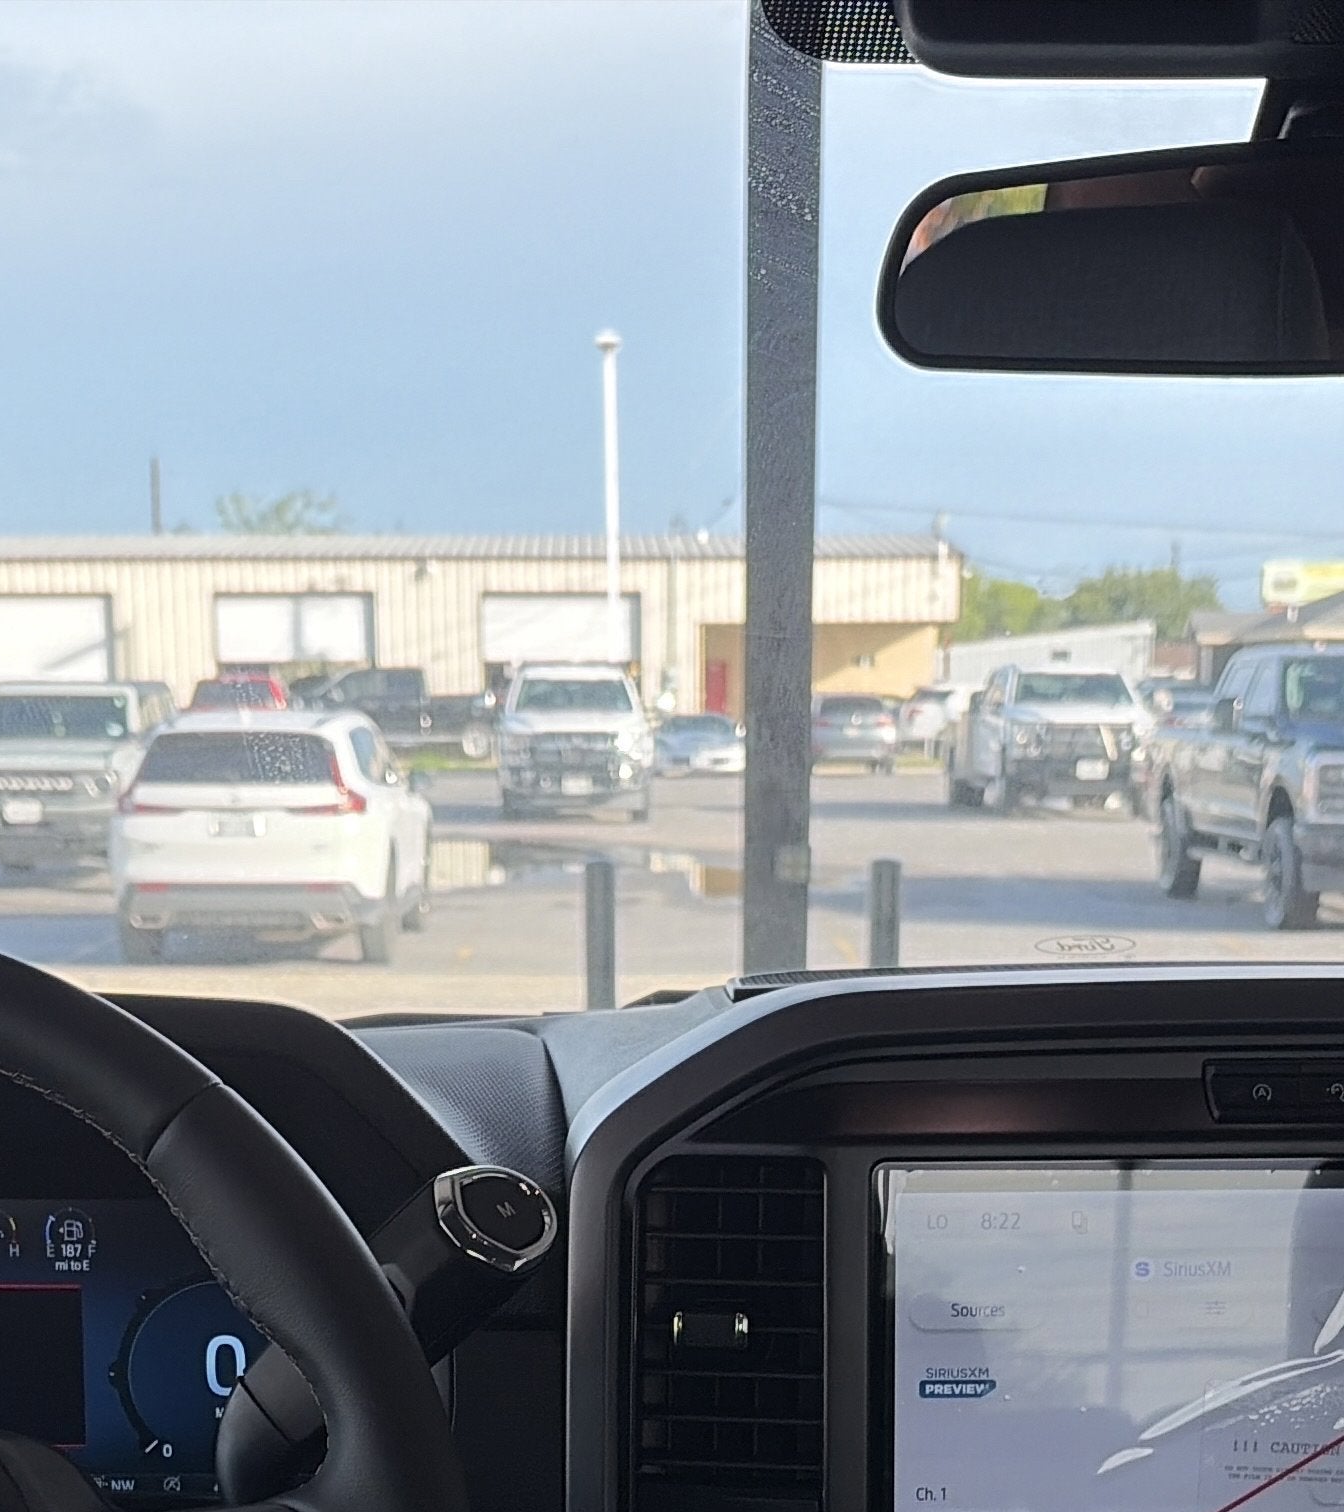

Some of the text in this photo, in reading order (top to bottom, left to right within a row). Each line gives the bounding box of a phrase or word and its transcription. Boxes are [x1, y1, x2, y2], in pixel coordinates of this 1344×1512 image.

[927, 1214, 948, 1230] LO
[981, 1212, 1021, 1230] 8:22
[10, 1244, 20, 1257] H
[47, 1244, 55, 1257] E
[60, 1244, 82, 1257] 187
[88, 1244, 96, 1257] F
[56, 1261, 90, 1271] mi to E
[1163, 1260, 1231, 1277] SiriusXM
[950, 1303, 1006, 1318] Sources
[206, 1334, 246, 1397] 0
[925, 1367, 990, 1379] SIRIUSXM
[162, 1443, 173, 1457] 0
[111, 1479, 135, 1491] NW
[915, 1487, 947, 1501] Ch. 1
